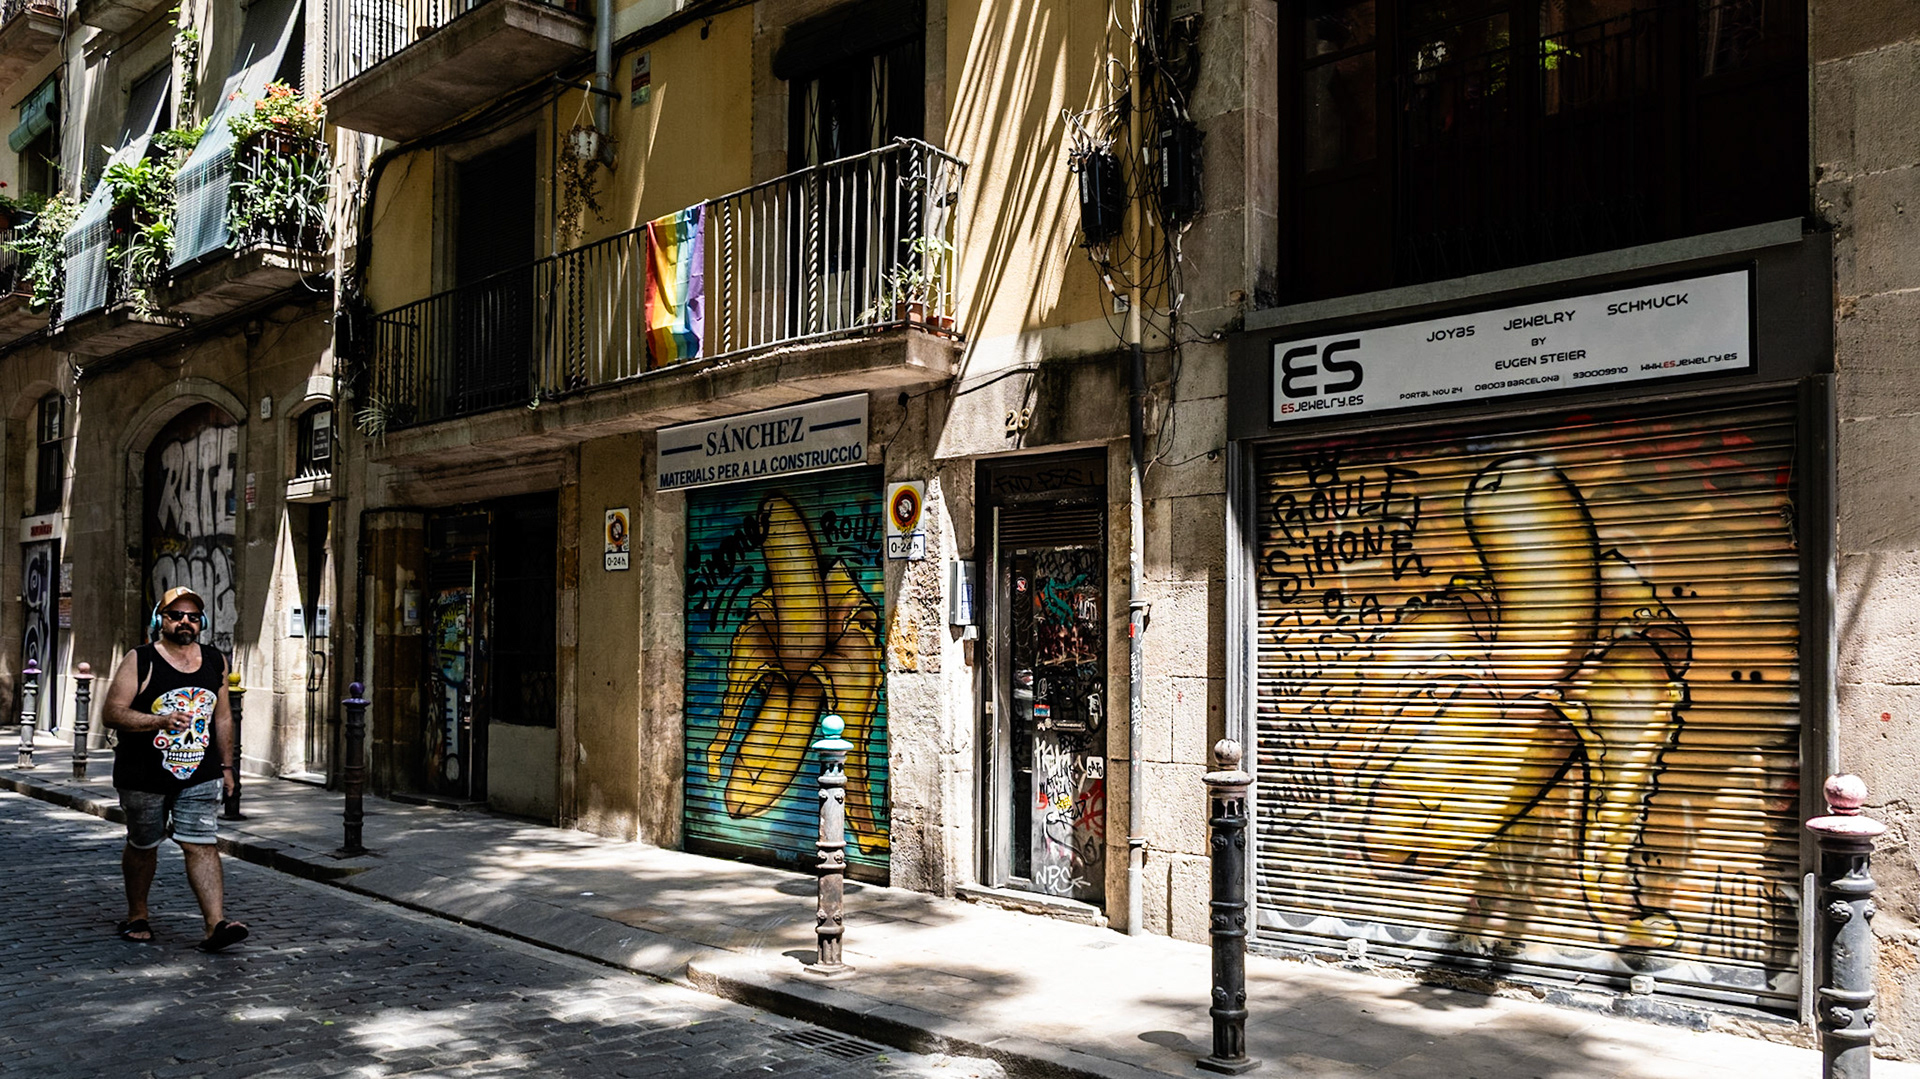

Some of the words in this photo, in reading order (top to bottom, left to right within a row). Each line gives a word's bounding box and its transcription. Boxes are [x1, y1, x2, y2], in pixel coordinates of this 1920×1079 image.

[1606, 292, 1689, 316] SCHMUCK
[1530, 336, 1547, 347] BY
[1281, 338, 1364, 399] ES
[1494, 355, 1538, 371] EUGEN
[1539, 349, 1587, 365] STEIER
[1432, 388, 1450, 397] NOU
[1451, 386, 1464, 395] 24
[1474, 380, 1506, 392] 08003
[1572, 365, 1629, 380] 930009910
[1004, 407, 1031, 431] 26
[705, 416, 805, 458] SÁNCHEZ
[659, 465, 715, 488] MATERIALS
[717, 461, 740, 480] PER
[741, 461, 750, 476] A
[752, 458, 768, 474] LA
[770, 441, 862, 472] CONSTRUCCIÓ
